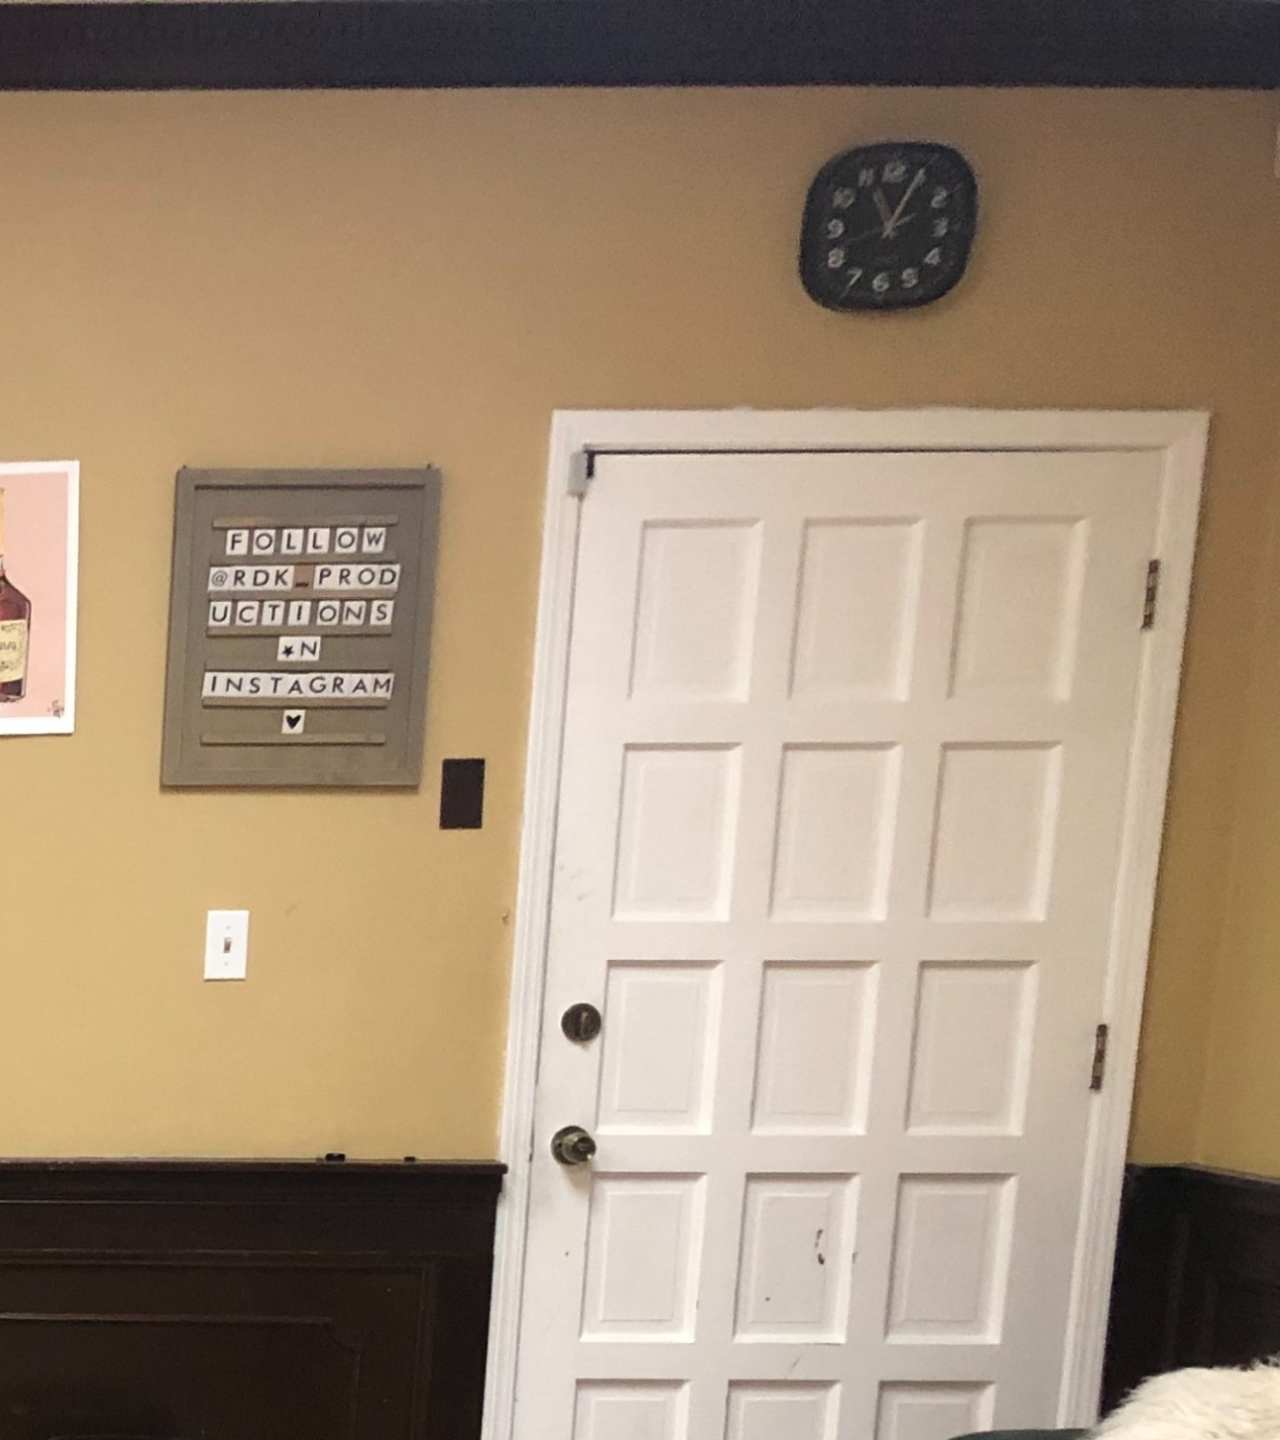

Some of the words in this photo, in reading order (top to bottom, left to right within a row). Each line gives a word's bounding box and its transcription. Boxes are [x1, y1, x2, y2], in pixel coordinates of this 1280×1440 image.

[827, 219, 845, 239] 9
[827, 247, 846, 269] 8
[924, 247, 941, 266] 4
[846, 268, 863, 288] 7
[872, 272, 890, 292] 6
[901, 268, 919, 288] 5
[229, 531, 384, 551] FOLLOW
[209, 567, 397, 588] @RDK_PROD
[211, 603, 388, 623] UCTIONS
[210, 674, 391, 695] INSTAGRAM
